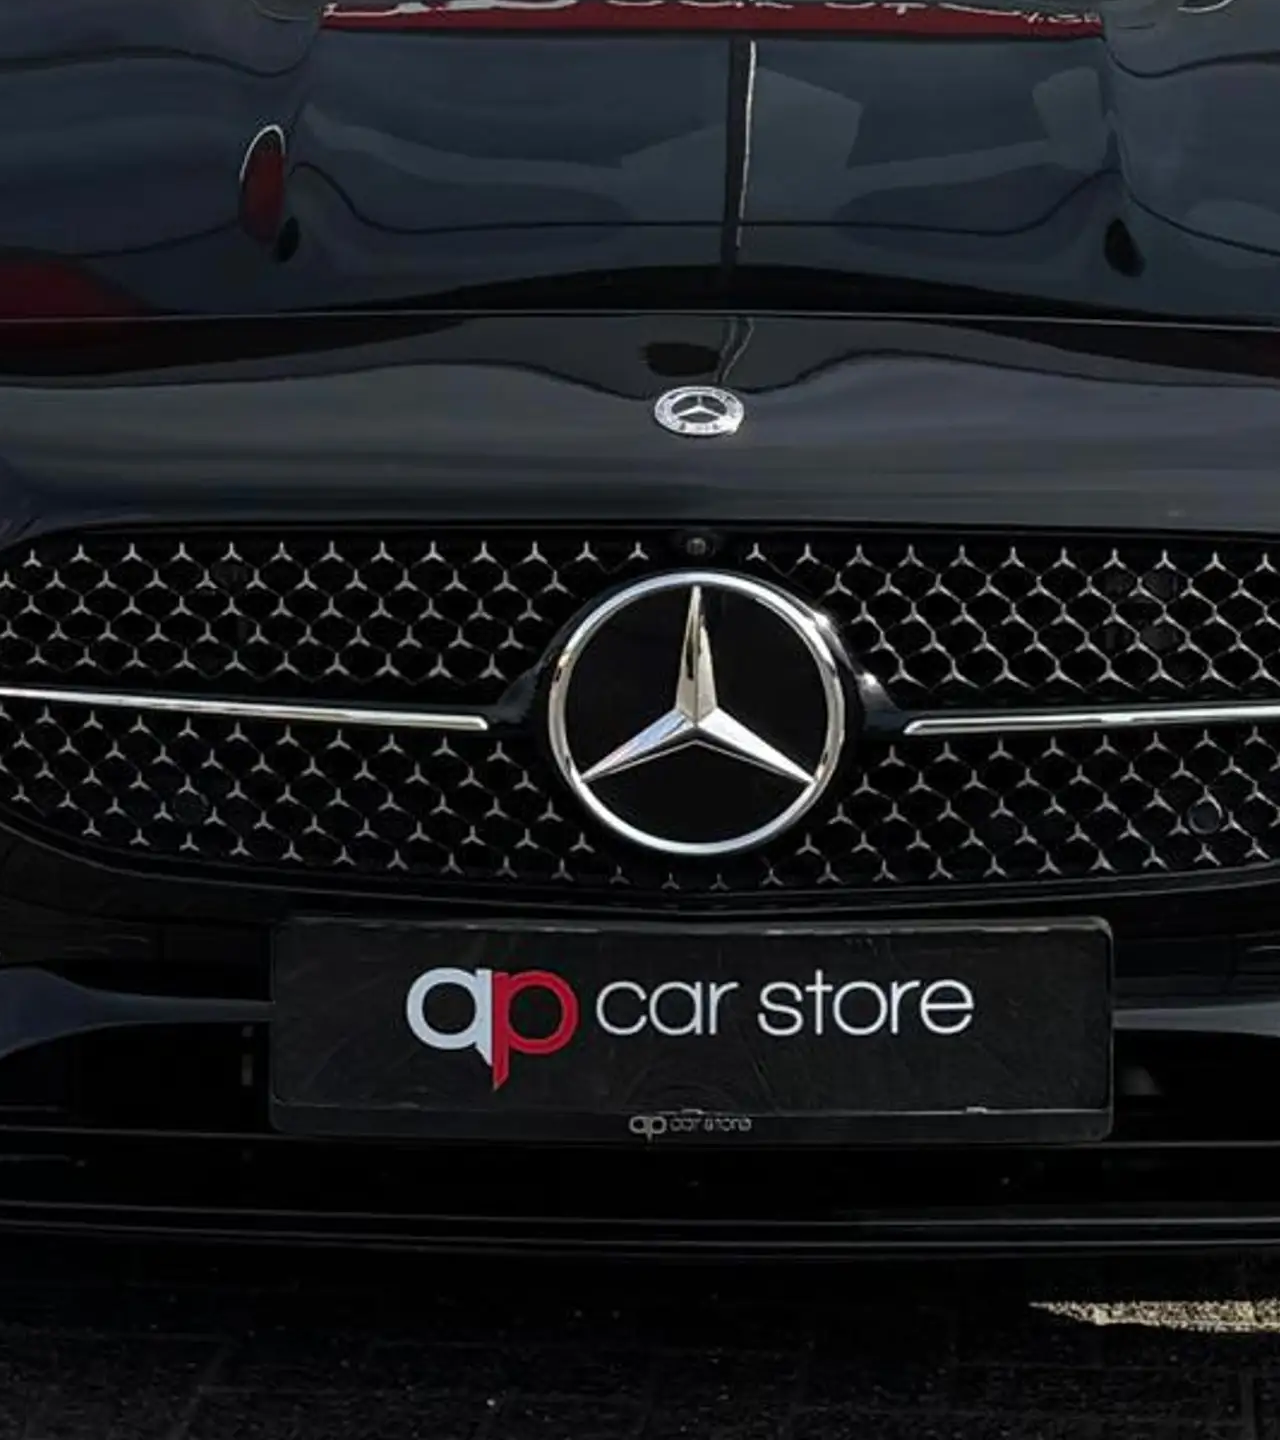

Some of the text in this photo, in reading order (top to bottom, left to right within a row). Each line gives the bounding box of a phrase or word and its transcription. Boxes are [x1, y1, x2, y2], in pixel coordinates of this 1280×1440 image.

[406, 967, 975, 1090] ap car store
